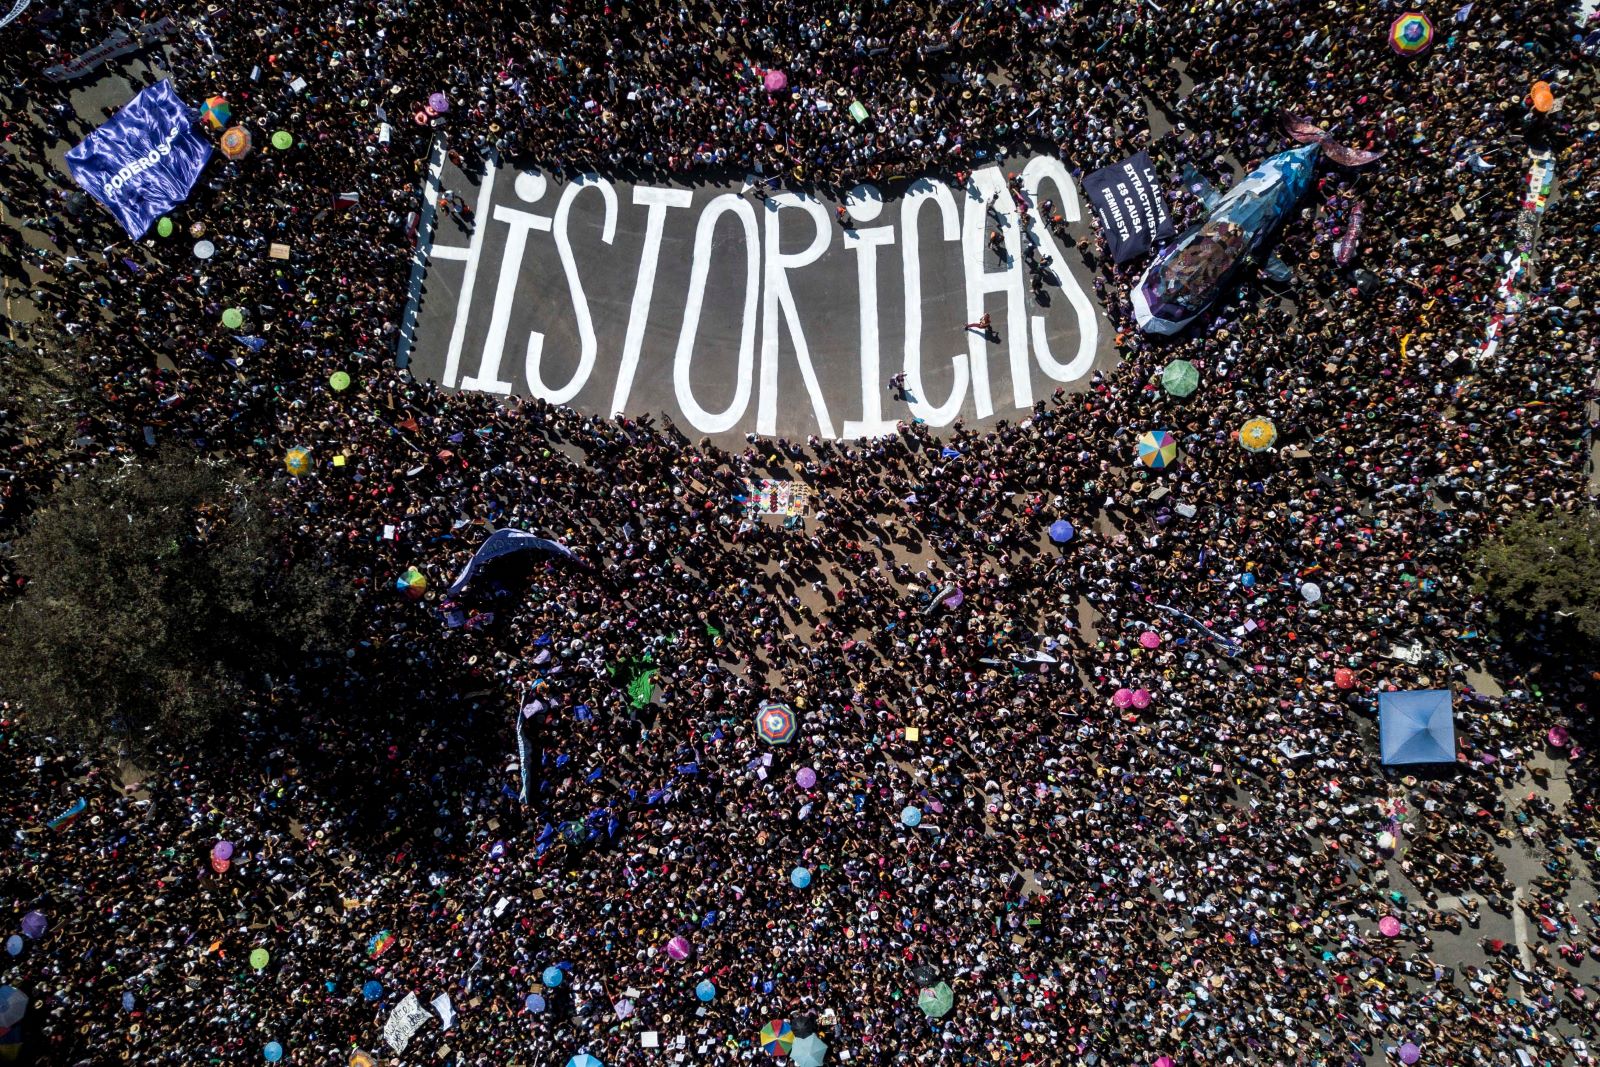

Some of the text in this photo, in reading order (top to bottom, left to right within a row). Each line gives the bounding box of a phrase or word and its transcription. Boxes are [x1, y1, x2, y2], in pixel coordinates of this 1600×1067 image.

[104, 127, 178, 197] PODEROSAS
[1143, 168, 1154, 182] LA
[1102, 187, 1130, 242] FEMINISTA
[1117, 183, 1142, 233] ES CAUSA
[1123, 163, 1156, 241] EXTRACTIVISTA
